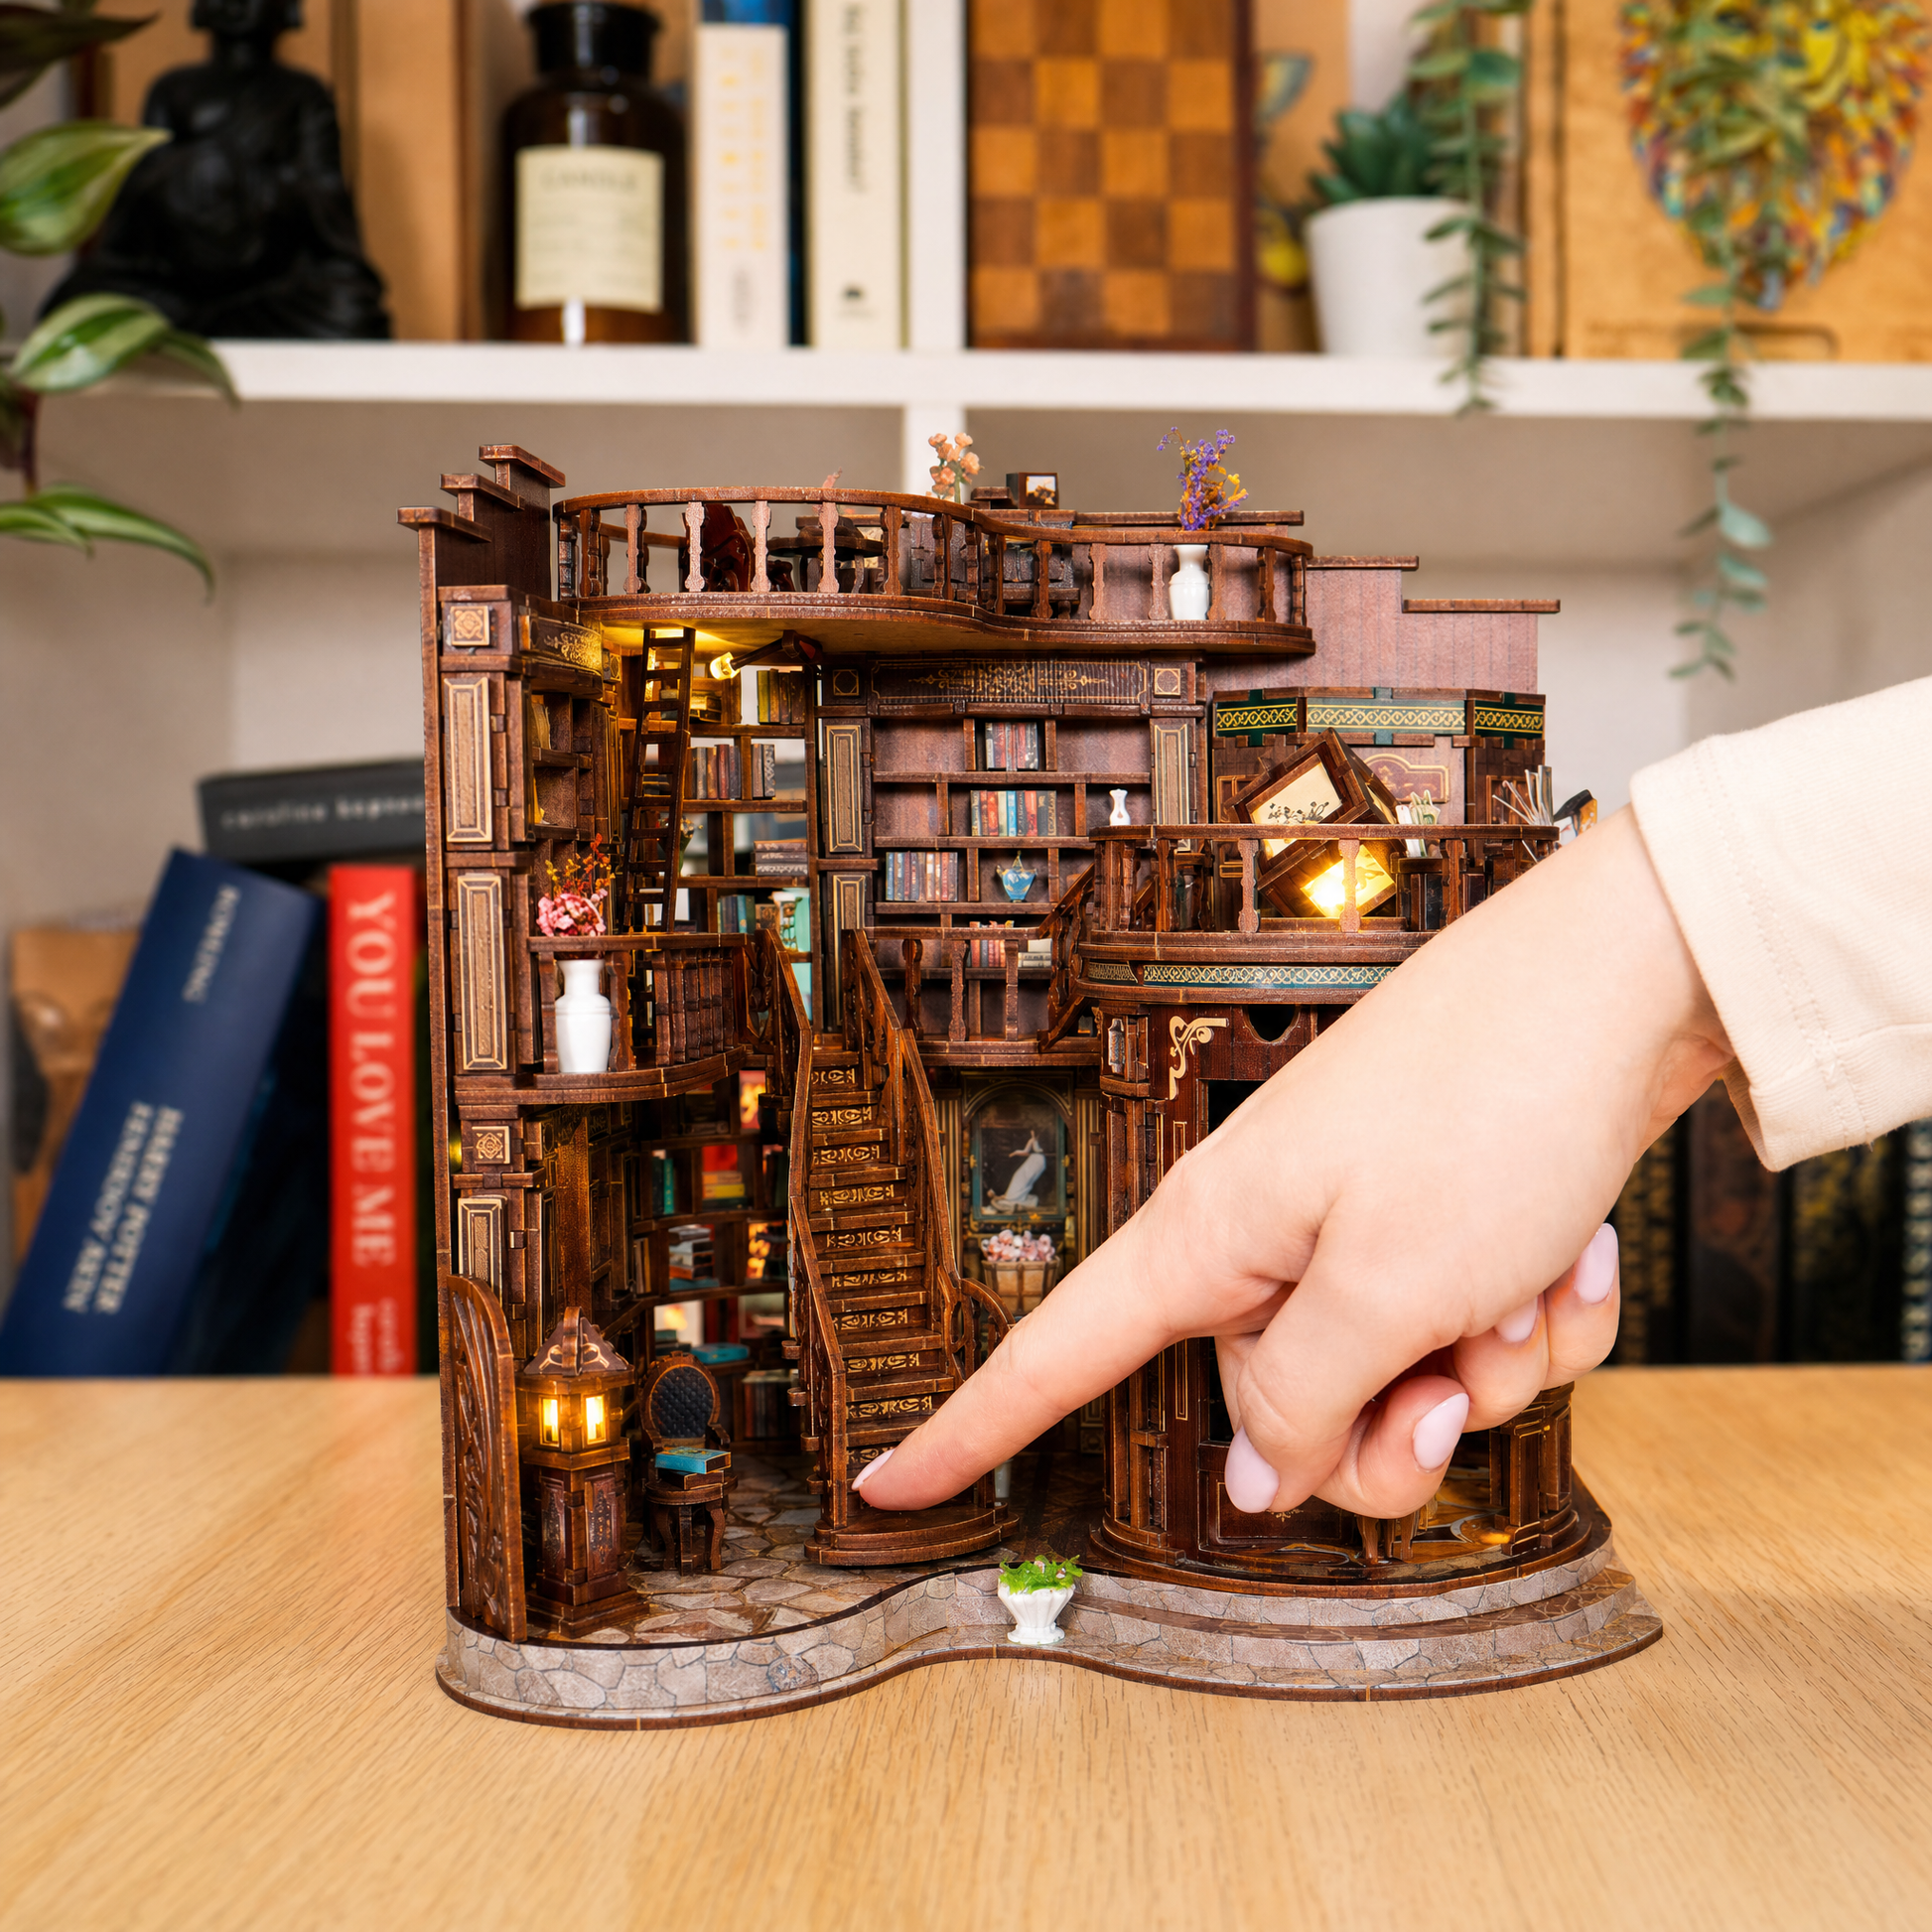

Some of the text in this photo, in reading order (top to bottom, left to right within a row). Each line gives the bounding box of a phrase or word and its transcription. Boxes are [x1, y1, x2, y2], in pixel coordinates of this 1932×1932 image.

[346, 891, 397, 1267] YOU LOVE ME
[135, 1106, 185, 1202] HARRY
[95, 1203, 151, 1315] POTTER
